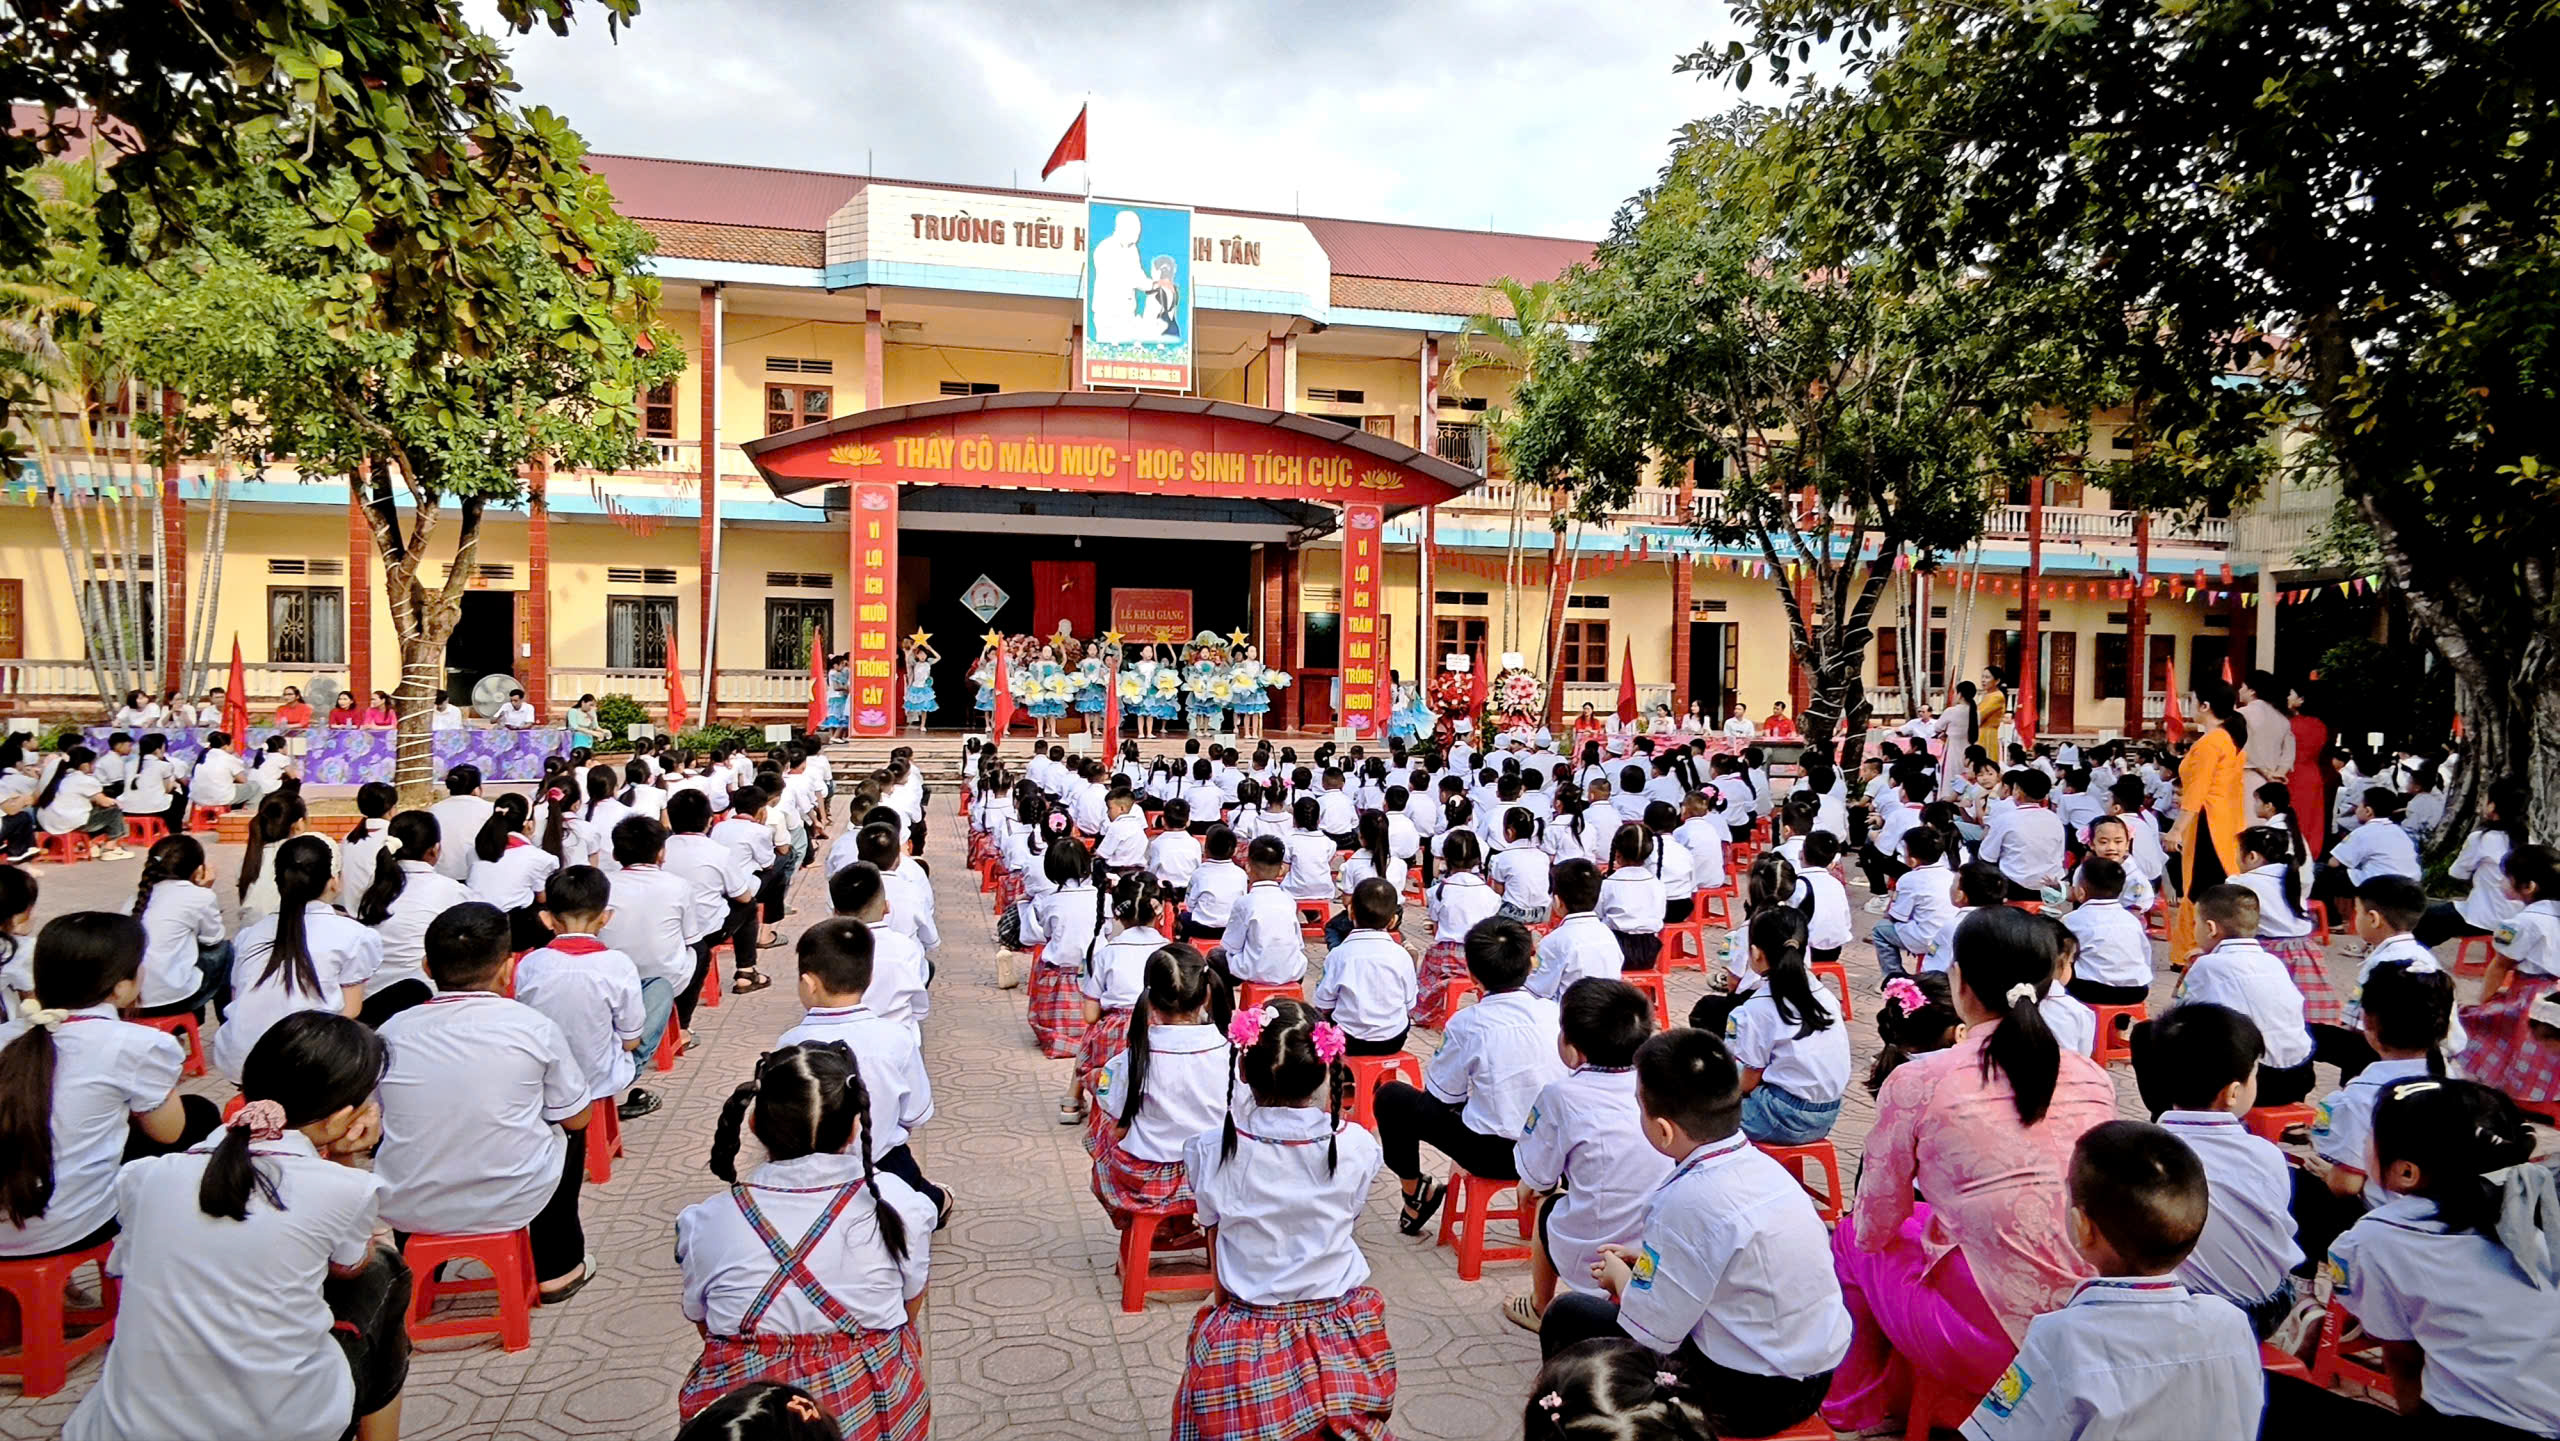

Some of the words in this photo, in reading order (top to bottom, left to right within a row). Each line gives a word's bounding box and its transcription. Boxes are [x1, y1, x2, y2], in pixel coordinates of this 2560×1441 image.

[911, 210, 1005, 245] TRƯỜNG
[1013, 217, 1063, 249] TIỂU
[1220, 235, 1261, 266] TÂN
[960, 434, 994, 471] CÔ
[1060, 444, 1117, 483] MỰC
[1137, 449, 1184, 486] HỌC
[1190, 451, 1245, 484] SINH
[1252, 449, 1302, 486] TÍCH
[1308, 455, 1353, 493] CỰC
[1134, 608, 1155, 620] KHAI
[862, 685, 884, 705] CÂY
